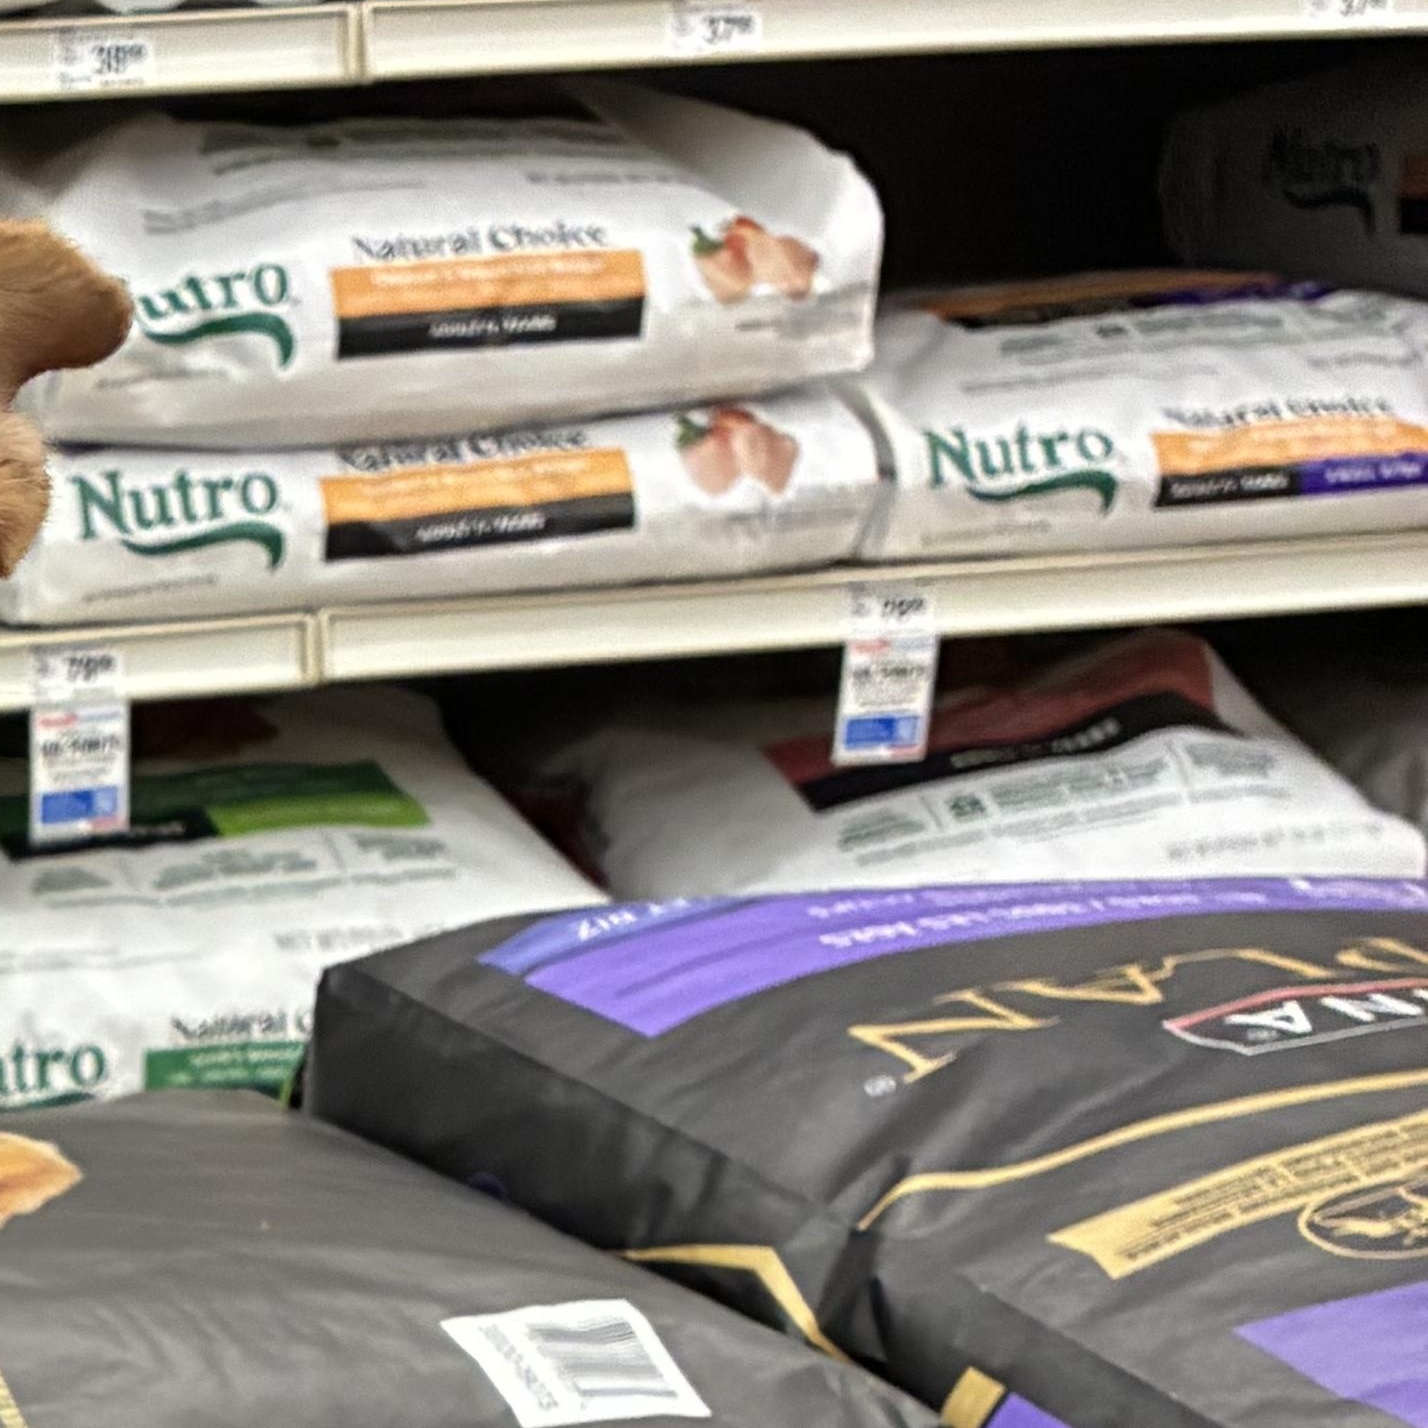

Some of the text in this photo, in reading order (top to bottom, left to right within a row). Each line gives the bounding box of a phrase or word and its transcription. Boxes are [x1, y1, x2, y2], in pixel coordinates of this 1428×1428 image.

[136, 262, 290, 333] utro
[923, 422, 1113, 489] Nutro
[69, 467, 279, 540] Nutro
